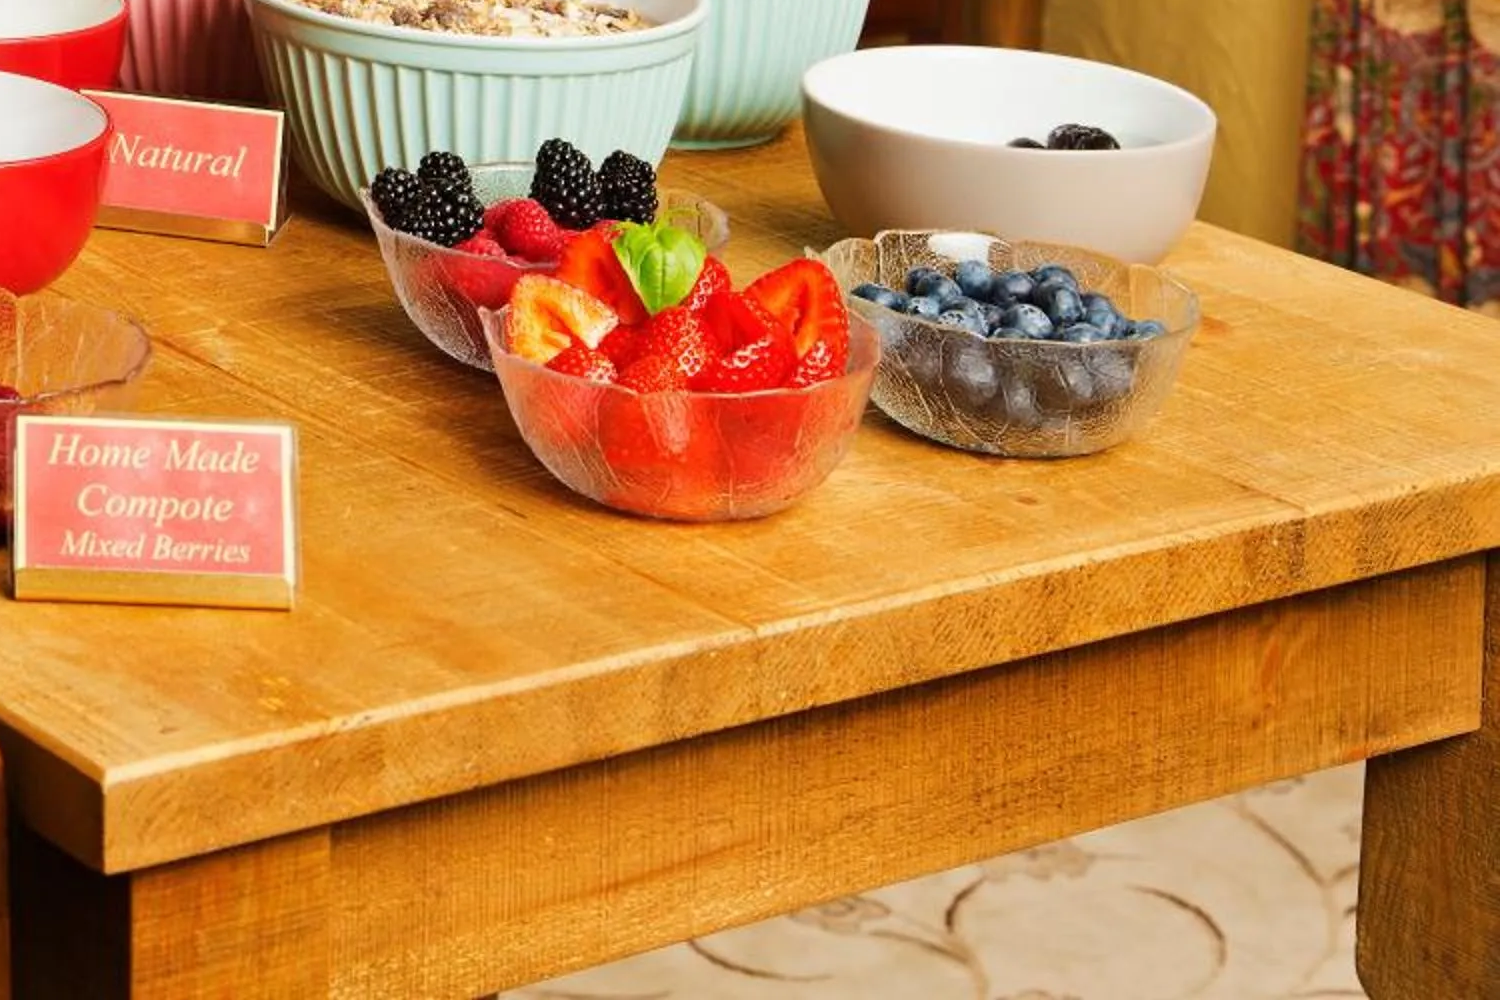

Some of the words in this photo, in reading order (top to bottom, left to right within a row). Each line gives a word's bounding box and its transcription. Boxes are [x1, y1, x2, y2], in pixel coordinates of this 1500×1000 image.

[108, 131, 248, 178] Natural
[47, 432, 150, 469] Home
[164, 439, 260, 474] Made
[77, 483, 235, 528] Compote
[60, 530, 146, 560] Mixed
[152, 533, 252, 564] Berries
